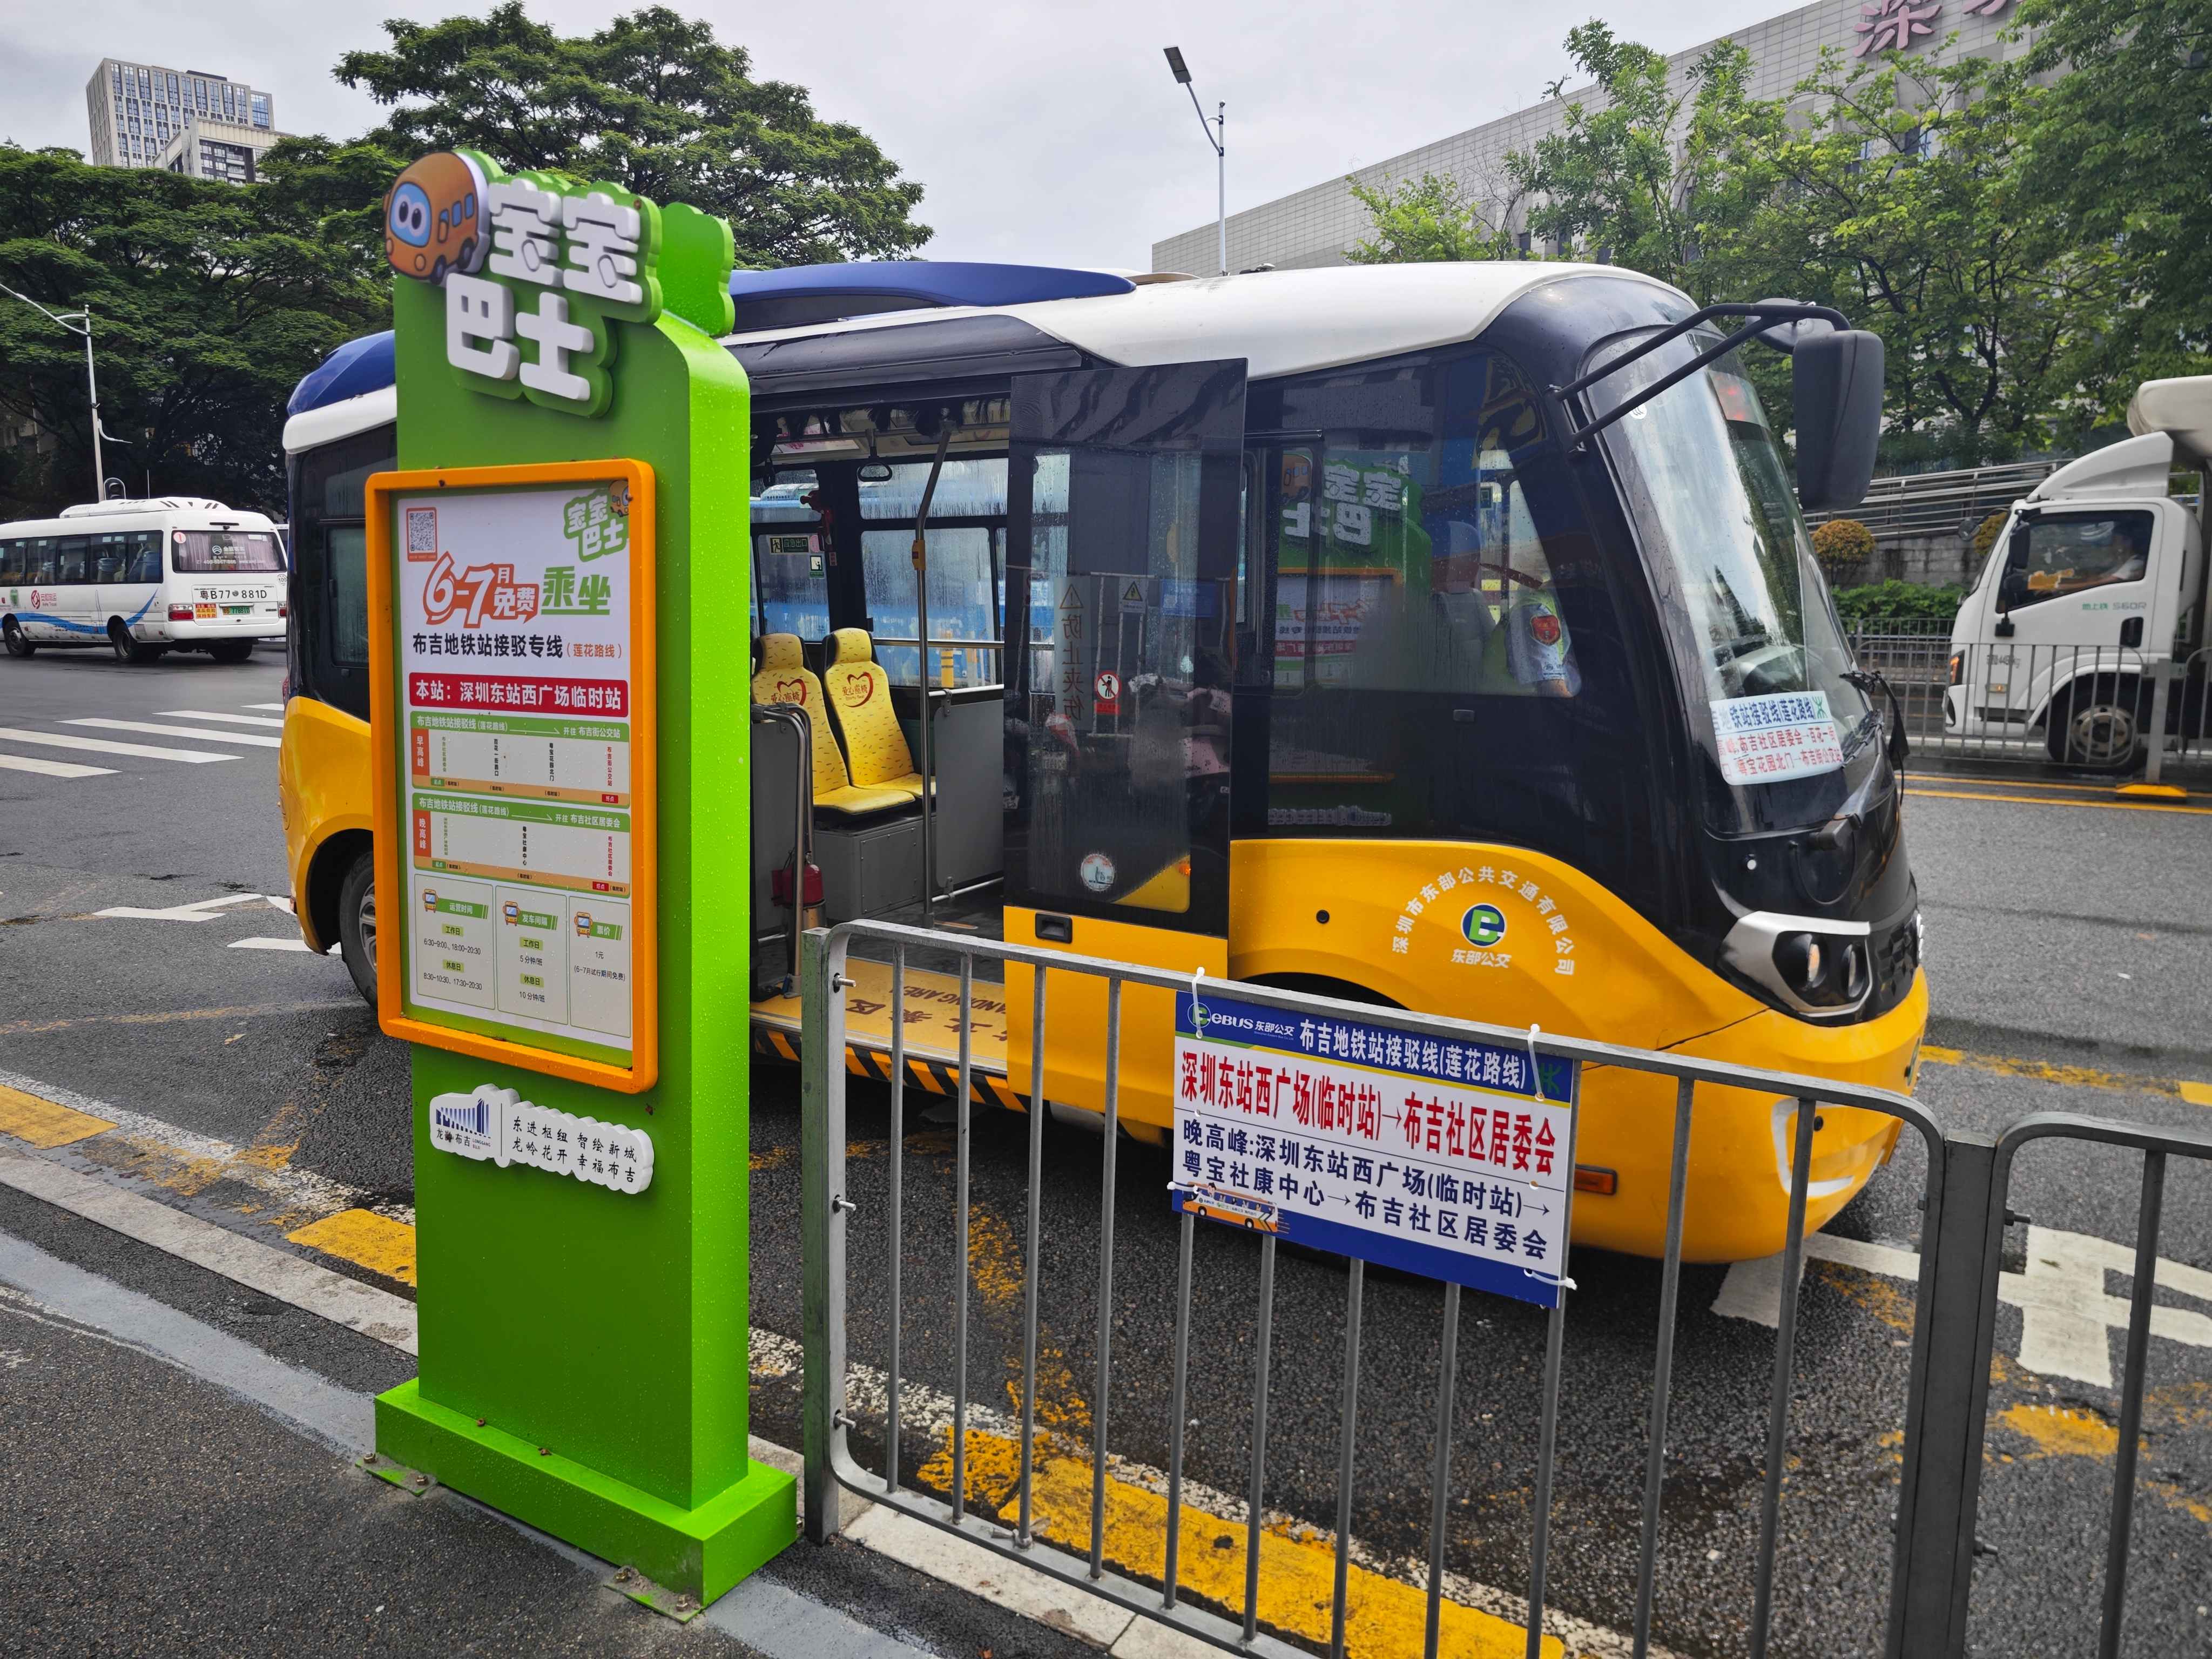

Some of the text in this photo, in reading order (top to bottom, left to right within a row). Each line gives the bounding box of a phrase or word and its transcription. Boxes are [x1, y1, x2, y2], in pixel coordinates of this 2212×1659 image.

[488, 178, 643, 305] 宝宝
[446, 272, 594, 401] 巴士
[568, 495, 608, 532] 宝宝
[582, 520, 624, 556] 巴士
[542, 565, 612, 610] 乘坐
[412, 632, 563, 659] 布吉地铁站接驳专线
[416, 715, 476, 730] 布吉地铁站接驳线
[563, 726, 576, 736] 开往
[419, 797, 478, 814] 布吉地铁站接驳线
[419, 818, 427, 850] 晚高峰
[555, 813, 621, 828] 开往 布吉社区居委会
[449, 902, 473, 915] 运营时间
[1392, 866, 1575, 976] 深圳市东部公共交通有限公司
[446, 926, 460, 936] 工作日
[523, 939, 539, 949] 工作日
[446, 961, 461, 972] 休息日
[1451, 948, 1512, 969] 东部公交
[524, 975, 540, 986] 休息日
[1211, 1013, 1527, 1090] eBUS 东部公交 布吉地铁站接驳线(莲花路线)
[436, 1128, 471, 1147] 龙布吉
[512, 1116, 637, 1163] 东进枢纽 智绘新城
[1403, 1092, 1556, 1177] 布吉社区居委会
[512, 1136, 635, 1183] 龙岭花开 幸福布吉
[1182, 1149, 1548, 1260] 粤宝社康中心 布吉社区居委会
